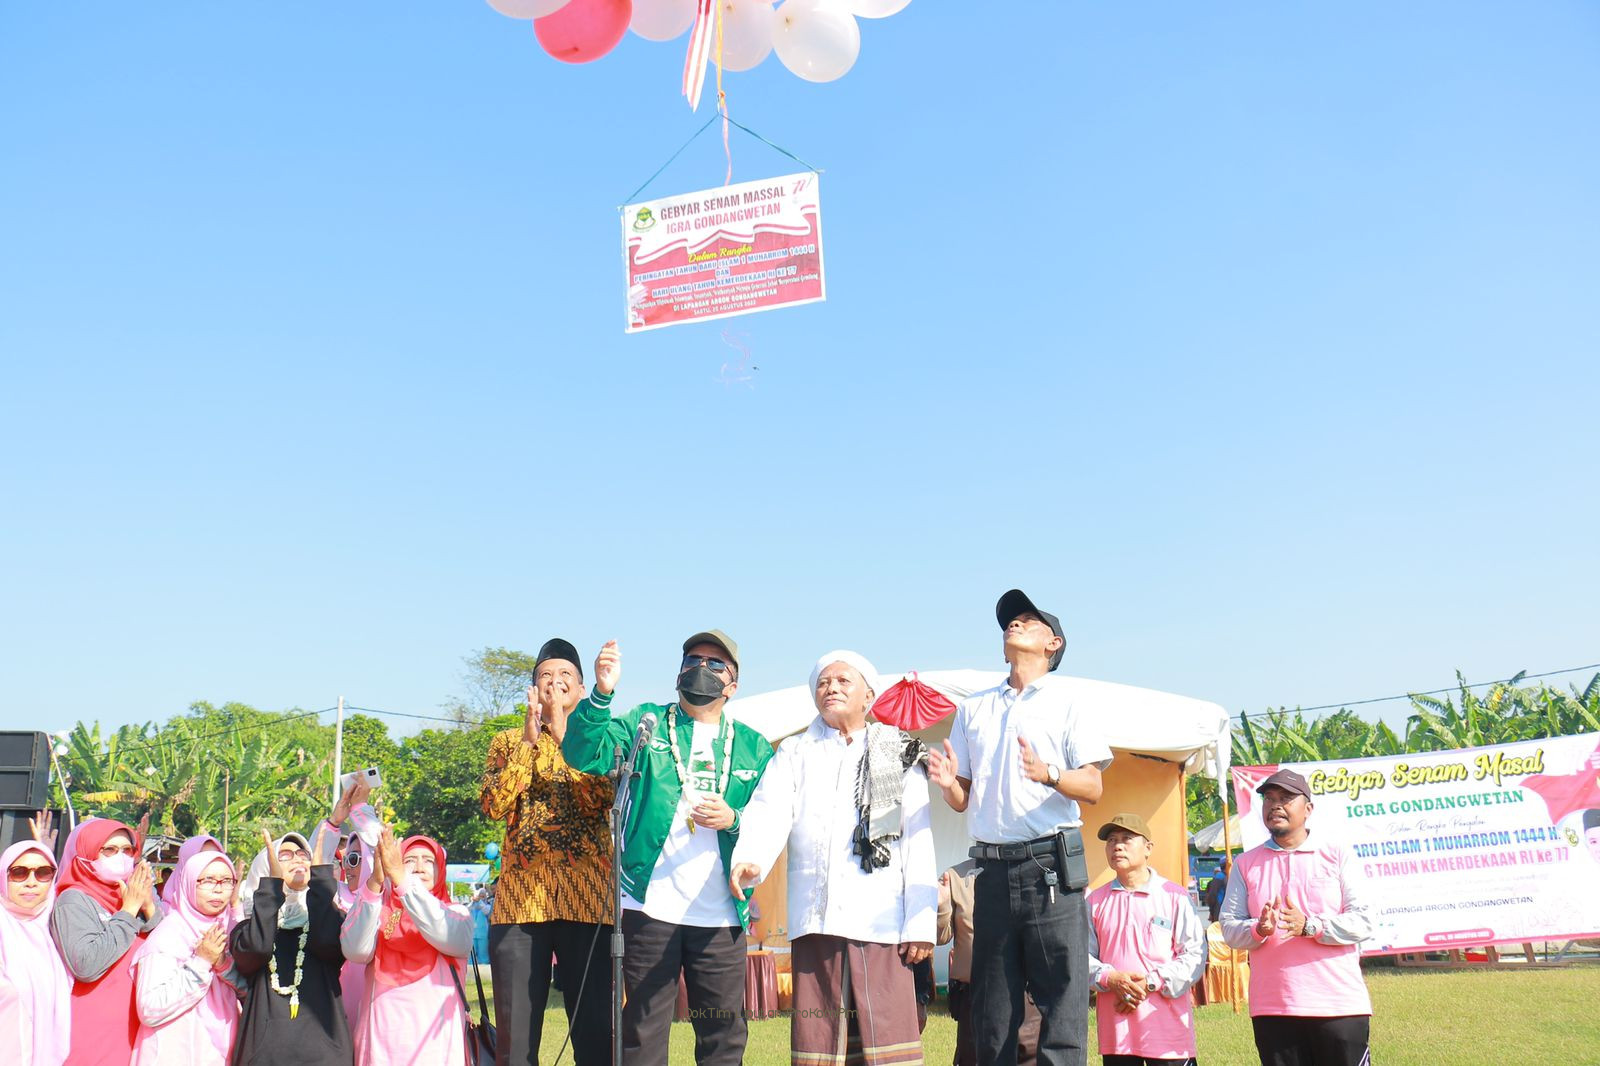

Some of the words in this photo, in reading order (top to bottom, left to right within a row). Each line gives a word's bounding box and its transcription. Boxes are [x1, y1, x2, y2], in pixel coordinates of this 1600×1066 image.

[661, 202, 700, 220] GEBYAR
[704, 195, 740, 211] SENAM
[744, 186, 785, 204] MASSAL
[667, 220, 691, 234] IGRA
[695, 202, 780, 230] GONDANGWETAN
[719, 244, 752, 258] Rangka
[715, 268, 730, 277] DAN
[1308, 768, 1384, 800] Gebyar
[1390, 760, 1466, 788] Senam
[1474, 749, 1544, 786] Masal
[1347, 803, 1385, 818] IGRA
[1390, 790, 1524, 814] GONDANGWETAN
[1381, 838, 1421, 856] ISLAM
[1424, 838, 1431, 852] 1
[1433, 830, 1511, 852] MUHARROM
[1513, 827, 1546, 844] 1444
[1375, 860, 1418, 877] TAHUN
[1421, 852, 1518, 874] KEMERDEKAAN
[1520, 850, 1534, 864] RI
[1554, 847, 1568, 861] 77
[1425, 903, 1456, 912] ARGON
[1458, 896, 1534, 910] GONDANGWETAN
